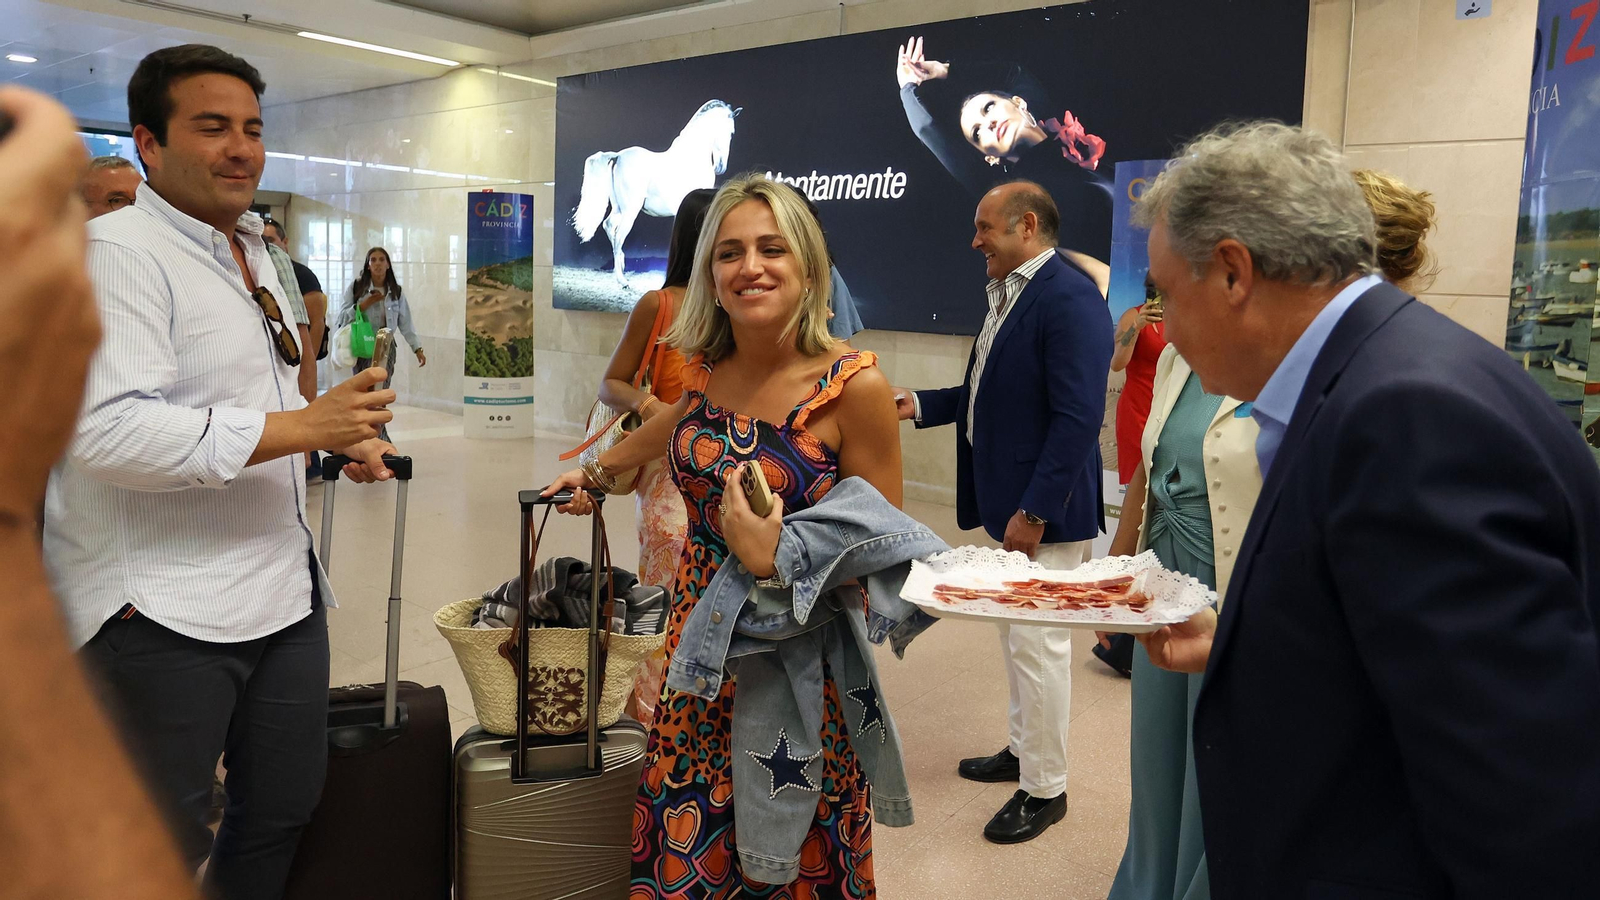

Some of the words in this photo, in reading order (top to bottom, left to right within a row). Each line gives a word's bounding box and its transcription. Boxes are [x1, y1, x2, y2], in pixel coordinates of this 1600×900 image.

[1531, 0, 1599, 76] IZ
[1530, 83, 1560, 114] CIA
[474, 199, 527, 218] CÁDIZ
